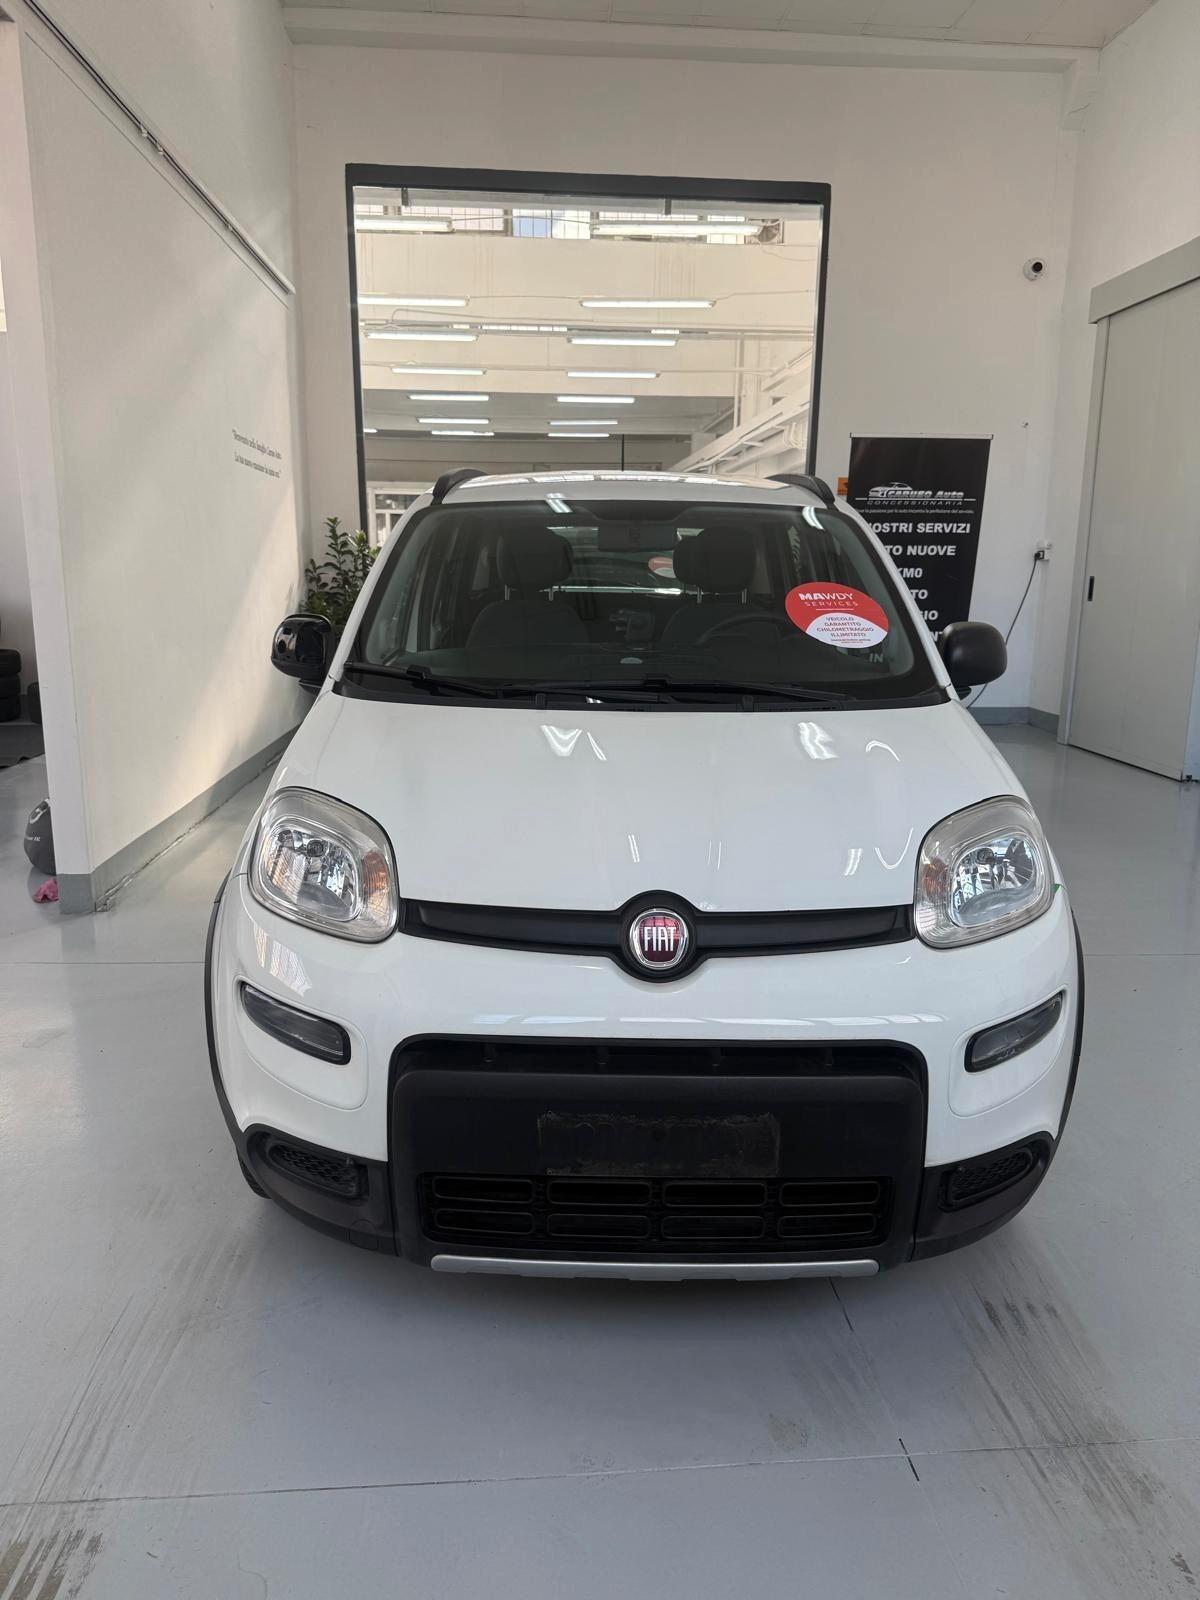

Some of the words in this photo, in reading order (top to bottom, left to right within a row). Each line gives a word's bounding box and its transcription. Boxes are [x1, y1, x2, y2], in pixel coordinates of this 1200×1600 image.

[869, 522, 913, 533] OSTRI
[916, 522, 971, 533] SERVIZI
[906, 545, 957, 556] NUOVE
[798, 592, 854, 600] MAWDY
[643, 926, 677, 952] FIAT
